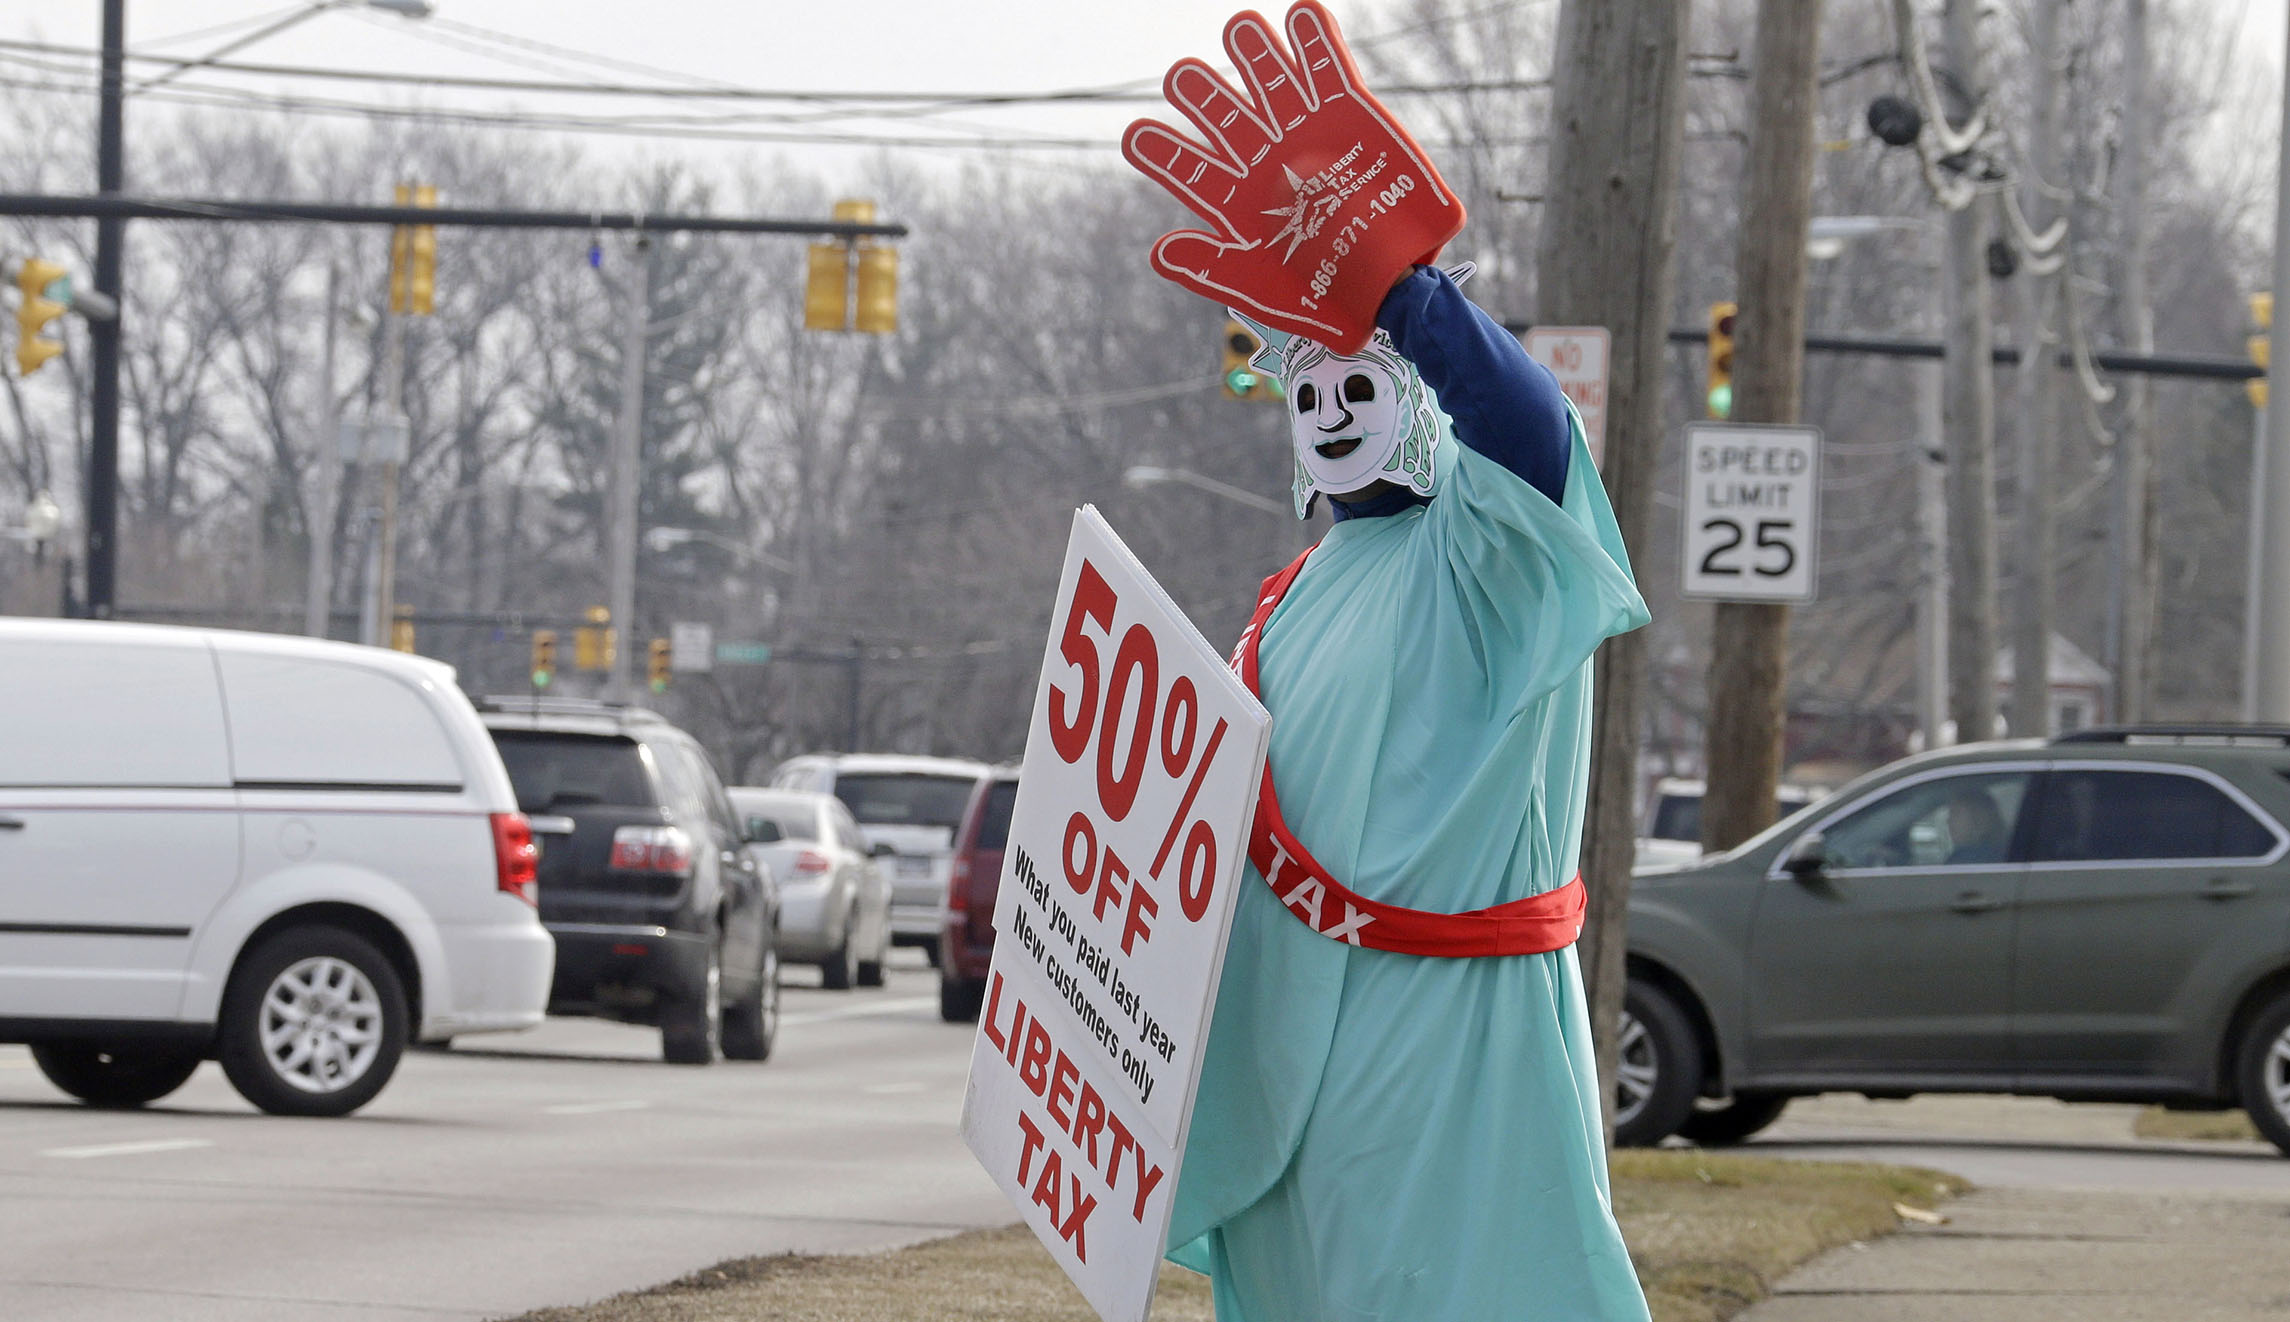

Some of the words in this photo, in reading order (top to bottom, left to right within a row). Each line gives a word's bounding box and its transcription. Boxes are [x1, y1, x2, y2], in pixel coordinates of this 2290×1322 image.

[1318, 141, 1364, 182] LIBERTY
[1327, 168, 1357, 190] TAX
[1551, 342, 1582, 372] NO
[1697, 446, 1808, 475] SPEED
[1706, 483, 1791, 509] LIMIT
[1700, 519, 1795, 577] 25
[1048, 558, 1228, 922] 50%
[1063, 812, 1159, 957] OFF
[1266, 832, 1376, 947] TAX
[1013, 903, 1046, 964] New
[1046, 954, 1120, 1058] customers
[1122, 1048, 1155, 1105] only
[1014, 844, 1051, 912] What
[1048, 899, 1077, 946] you
[1076, 934, 1111, 987] paid
[1110, 967, 1141, 1025] last
[1140, 1010, 1176, 1064] year
[984, 970, 1164, 1224] LIBERTY
[1017, 1110, 1098, 1266] TAX
